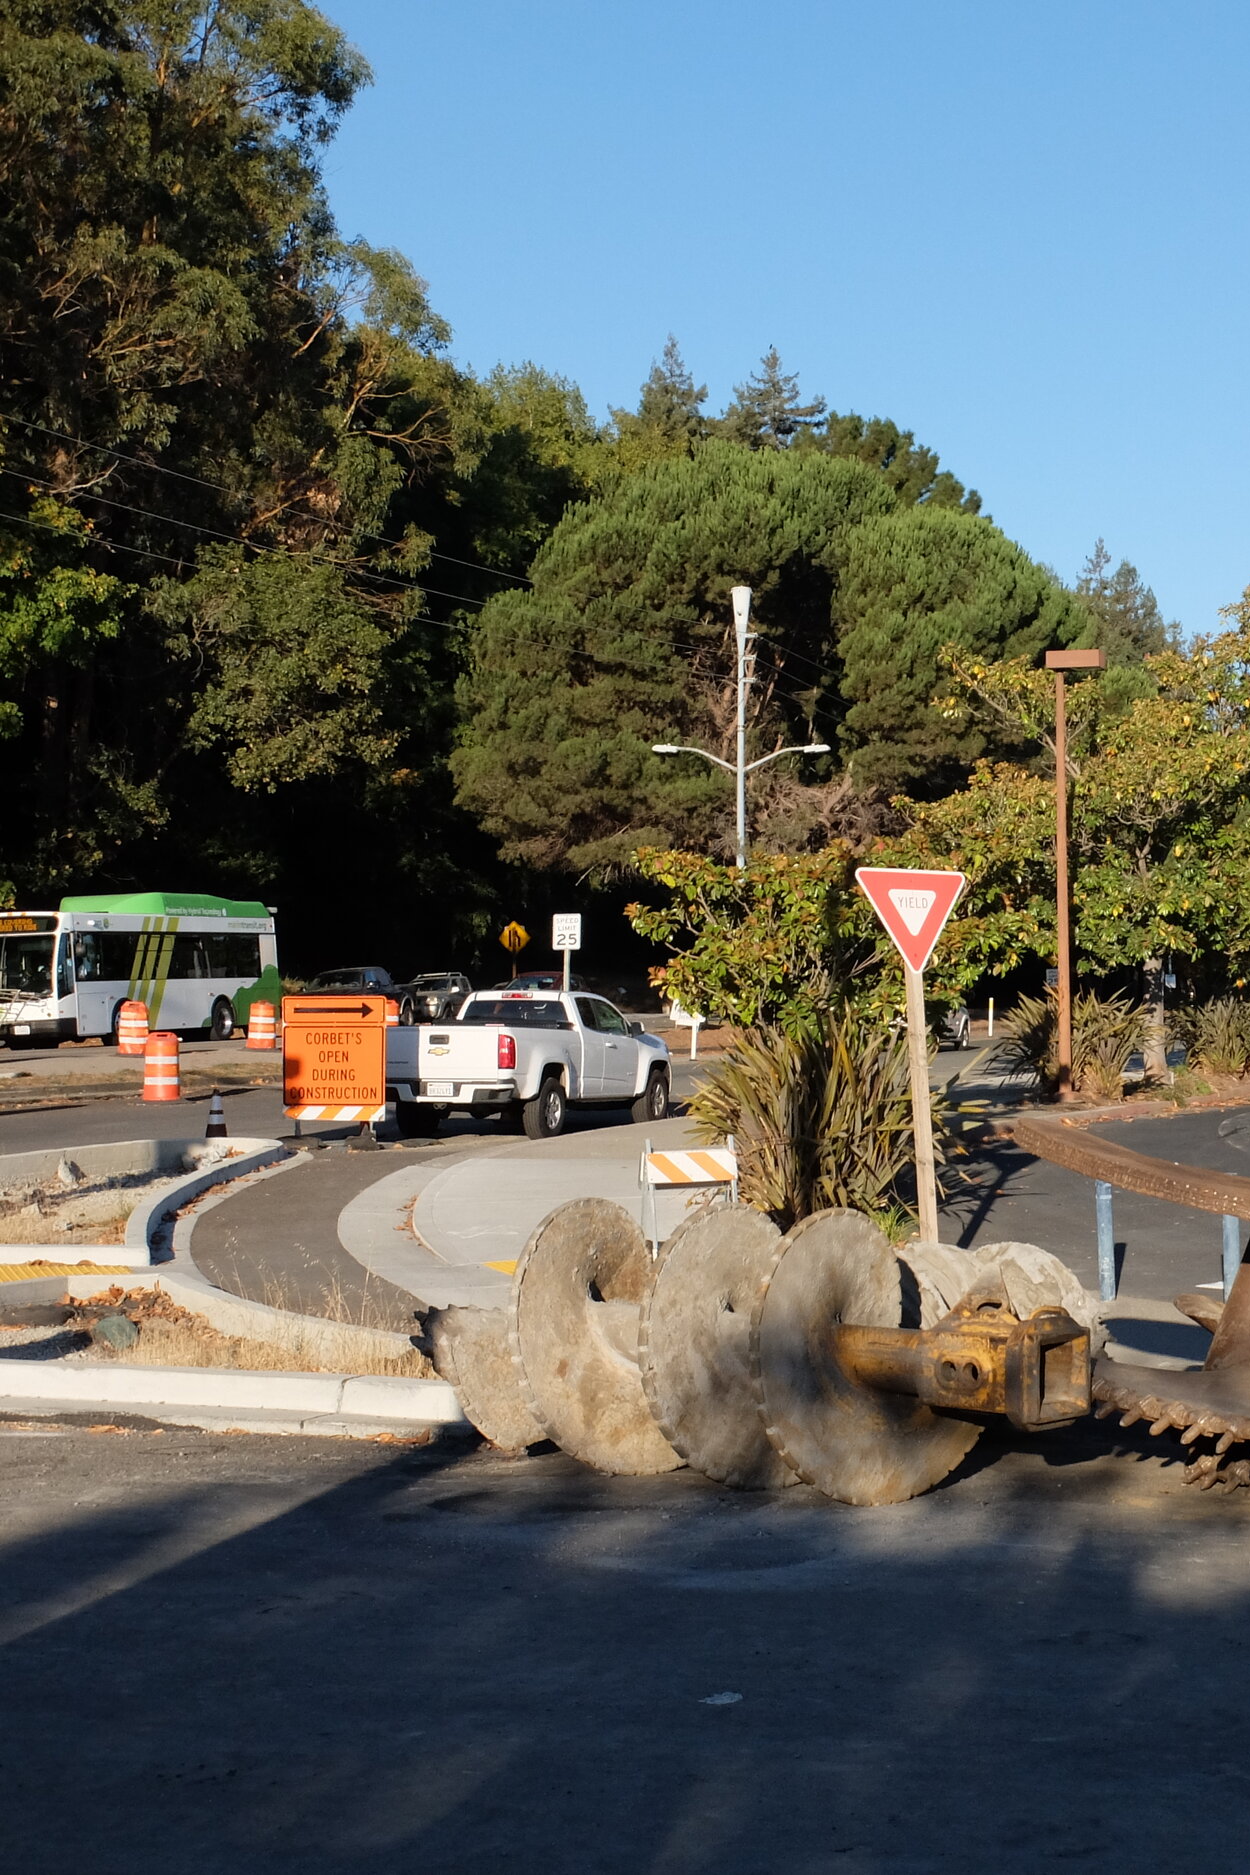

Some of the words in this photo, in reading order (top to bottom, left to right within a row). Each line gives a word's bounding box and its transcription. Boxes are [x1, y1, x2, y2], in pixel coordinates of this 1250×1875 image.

[897, 896, 928, 909] YIELD
[556, 933, 577, 946] 25
[305, 1032, 363, 1045] CORBET'S
[318, 1050, 349, 1063] OPEN
[312, 1068, 356, 1081] DURING
[290, 1086, 378, 1099] CONSTRUCTION
